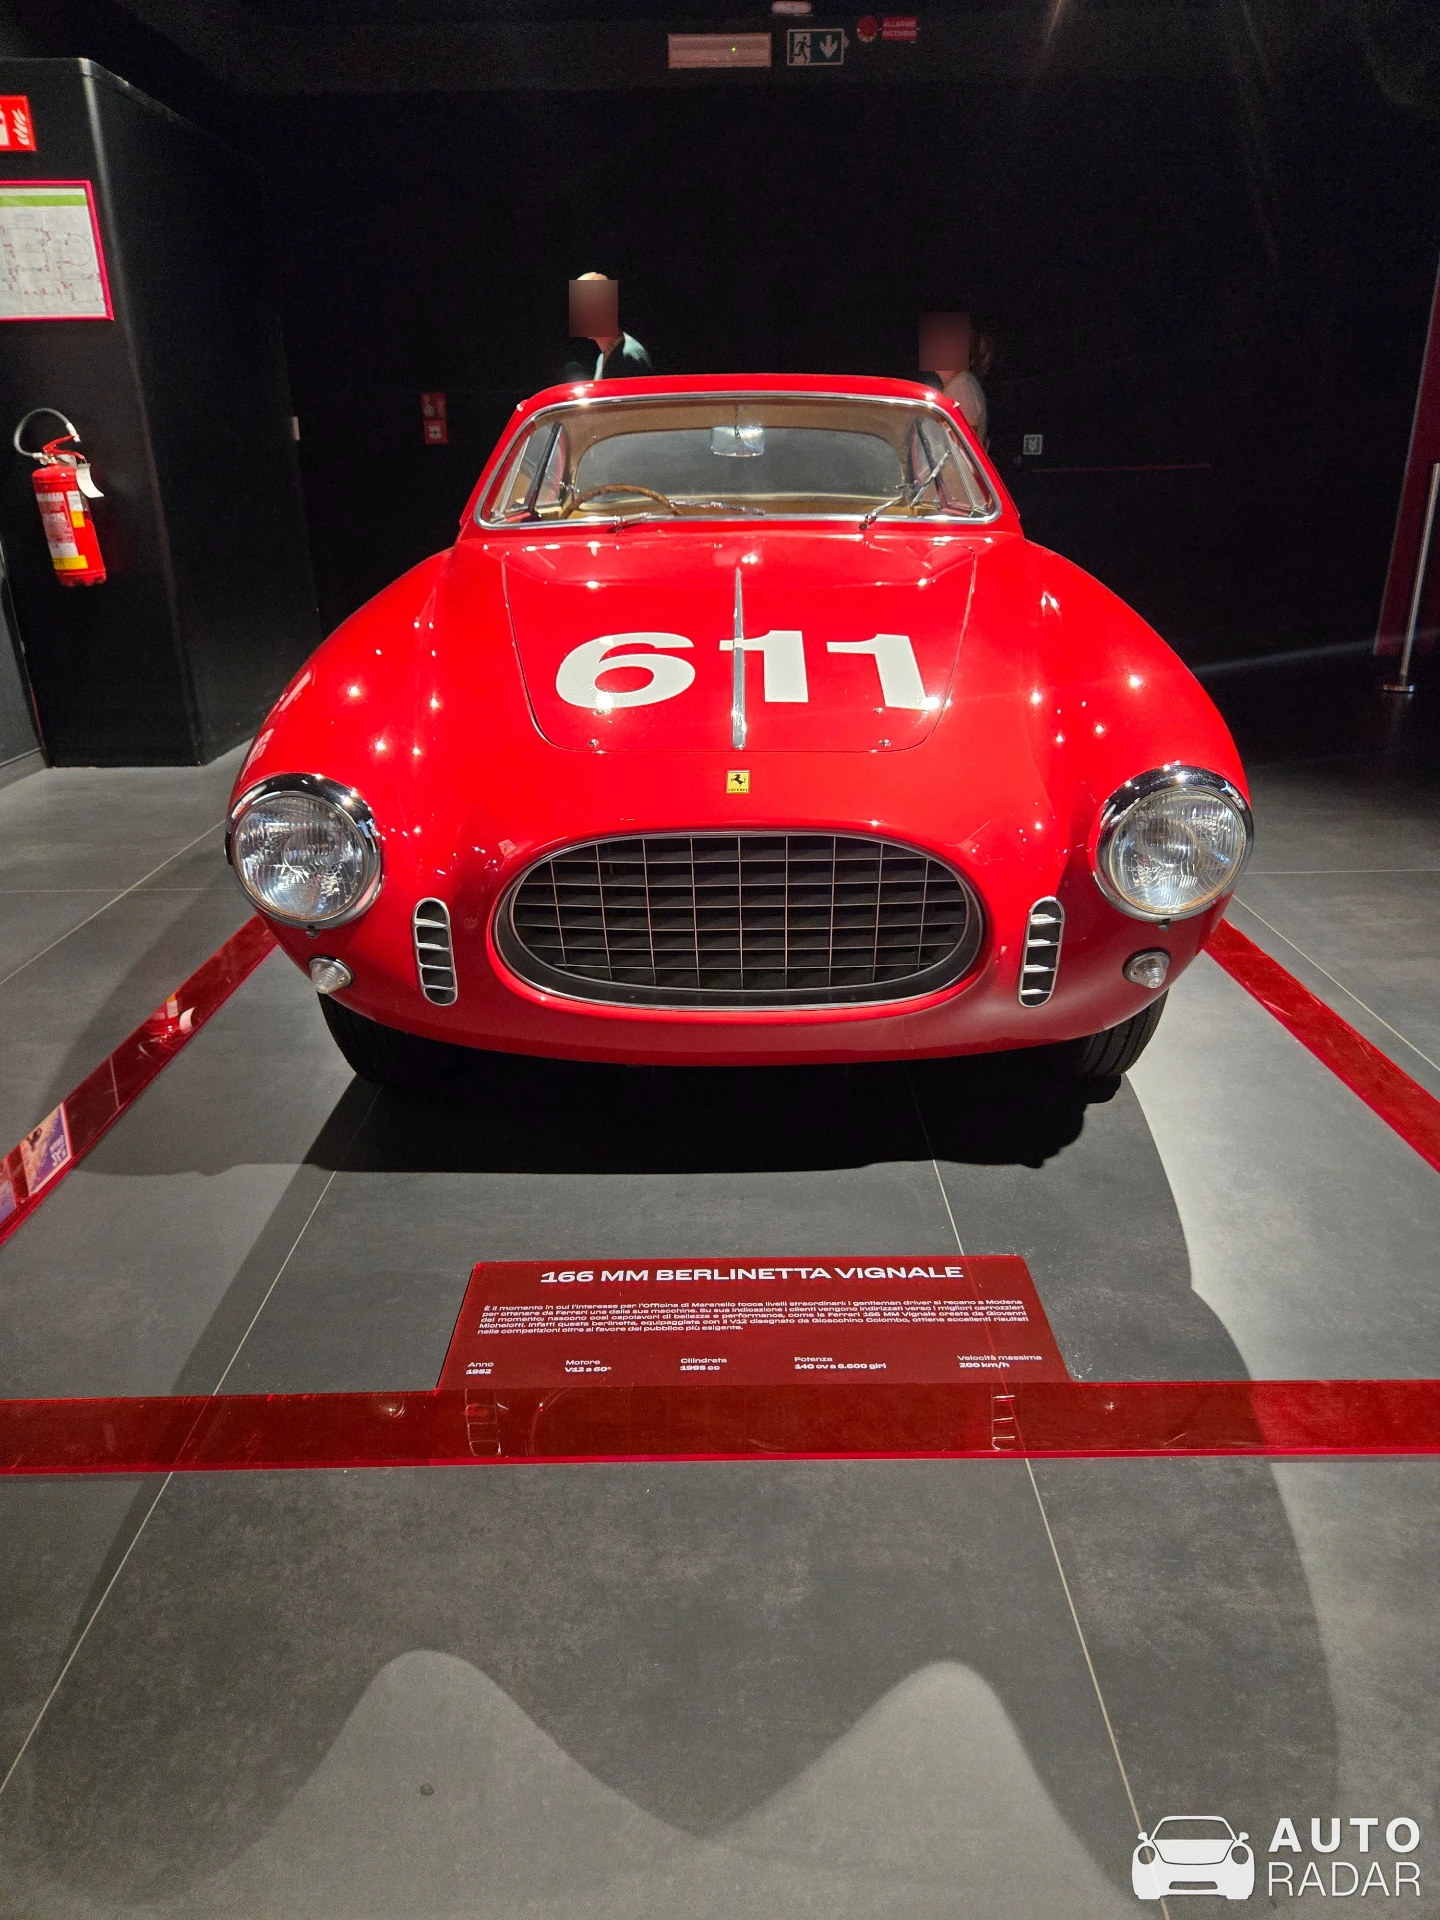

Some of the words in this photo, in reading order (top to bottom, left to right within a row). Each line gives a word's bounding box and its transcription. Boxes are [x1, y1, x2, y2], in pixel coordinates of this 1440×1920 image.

[556, 629, 928, 710] 611
[541, 1270, 594, 1283] 166
[601, 1270, 648, 1281] MM
[656, 1268, 831, 1280] BERLINETTA
[834, 1266, 963, 1279] VIGNALE
[869, 1362, 886, 1370] giri
